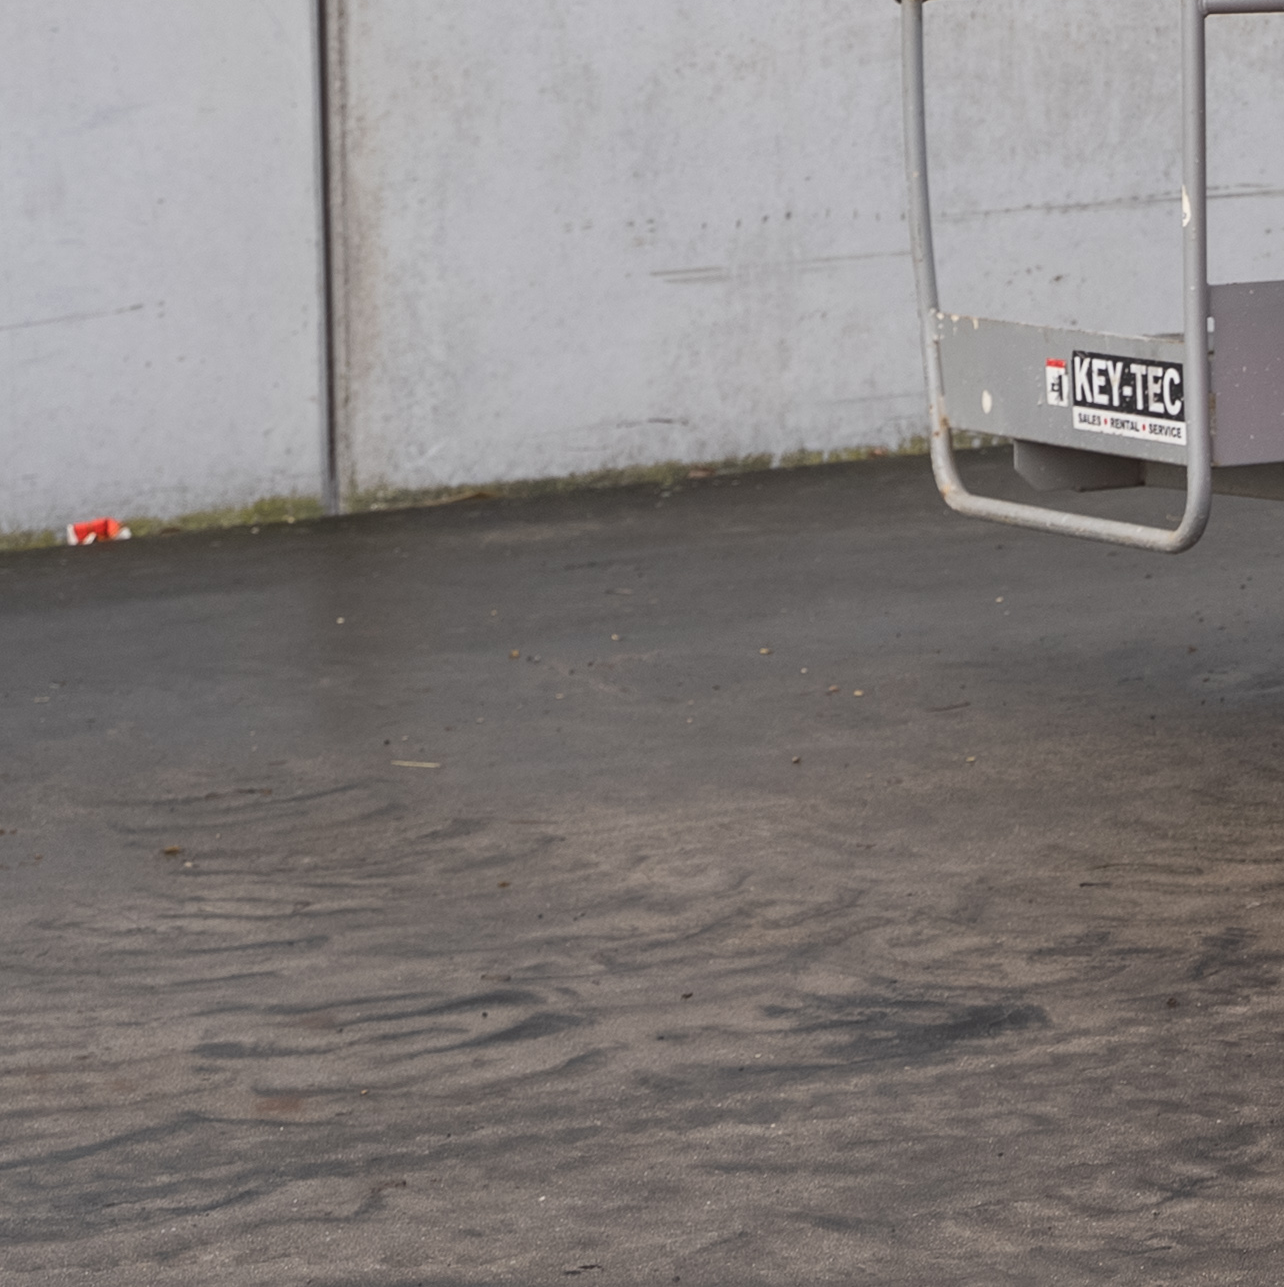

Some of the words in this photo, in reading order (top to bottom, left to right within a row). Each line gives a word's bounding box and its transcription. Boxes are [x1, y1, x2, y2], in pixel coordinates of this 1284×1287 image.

[1073, 356, 1183, 416] KEY-TEC
[1077, 412, 1102, 427] SALES
[1110, 418, 1140, 433] RENTAL
[1148, 423, 1183, 439] SERVICE
